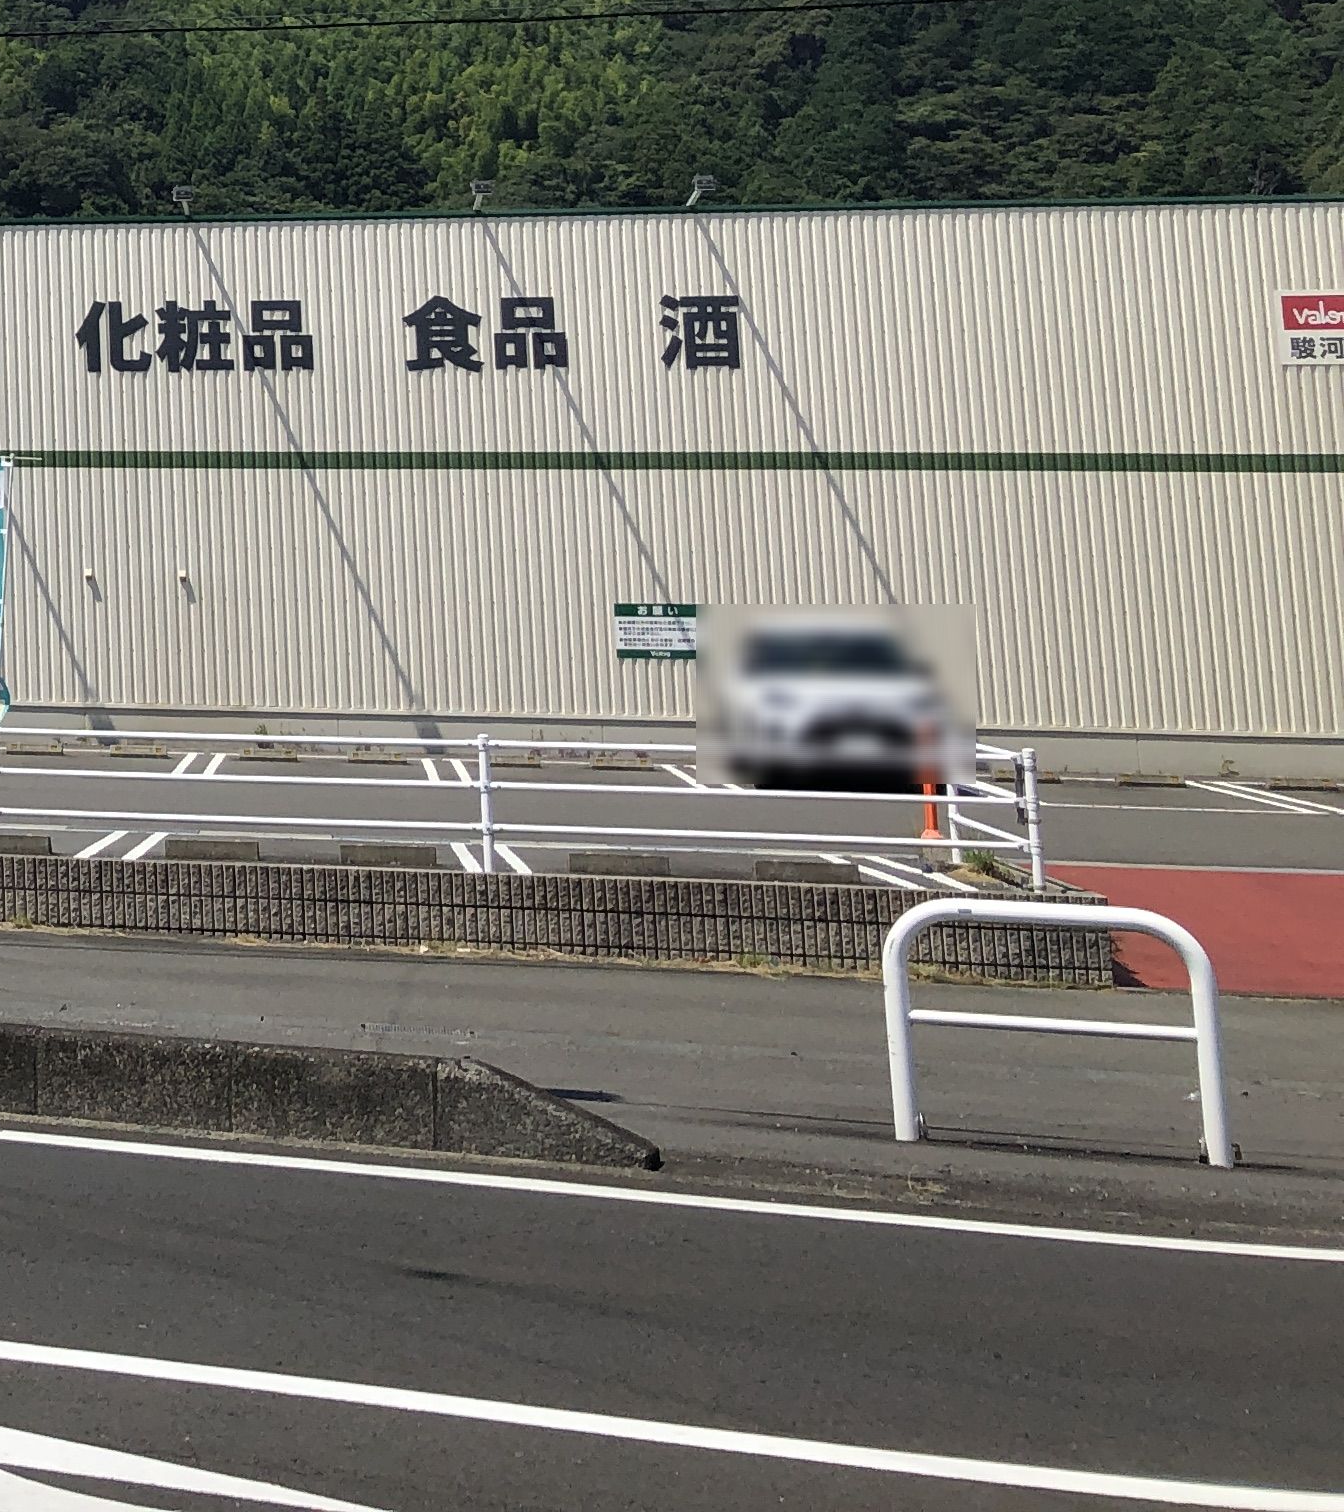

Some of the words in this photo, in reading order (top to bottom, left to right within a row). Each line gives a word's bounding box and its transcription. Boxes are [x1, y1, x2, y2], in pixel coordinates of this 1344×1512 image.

[75, 299, 315, 373] 化粧品
[403, 295, 568, 372] 食品
[658, 294, 740, 370] 酒
